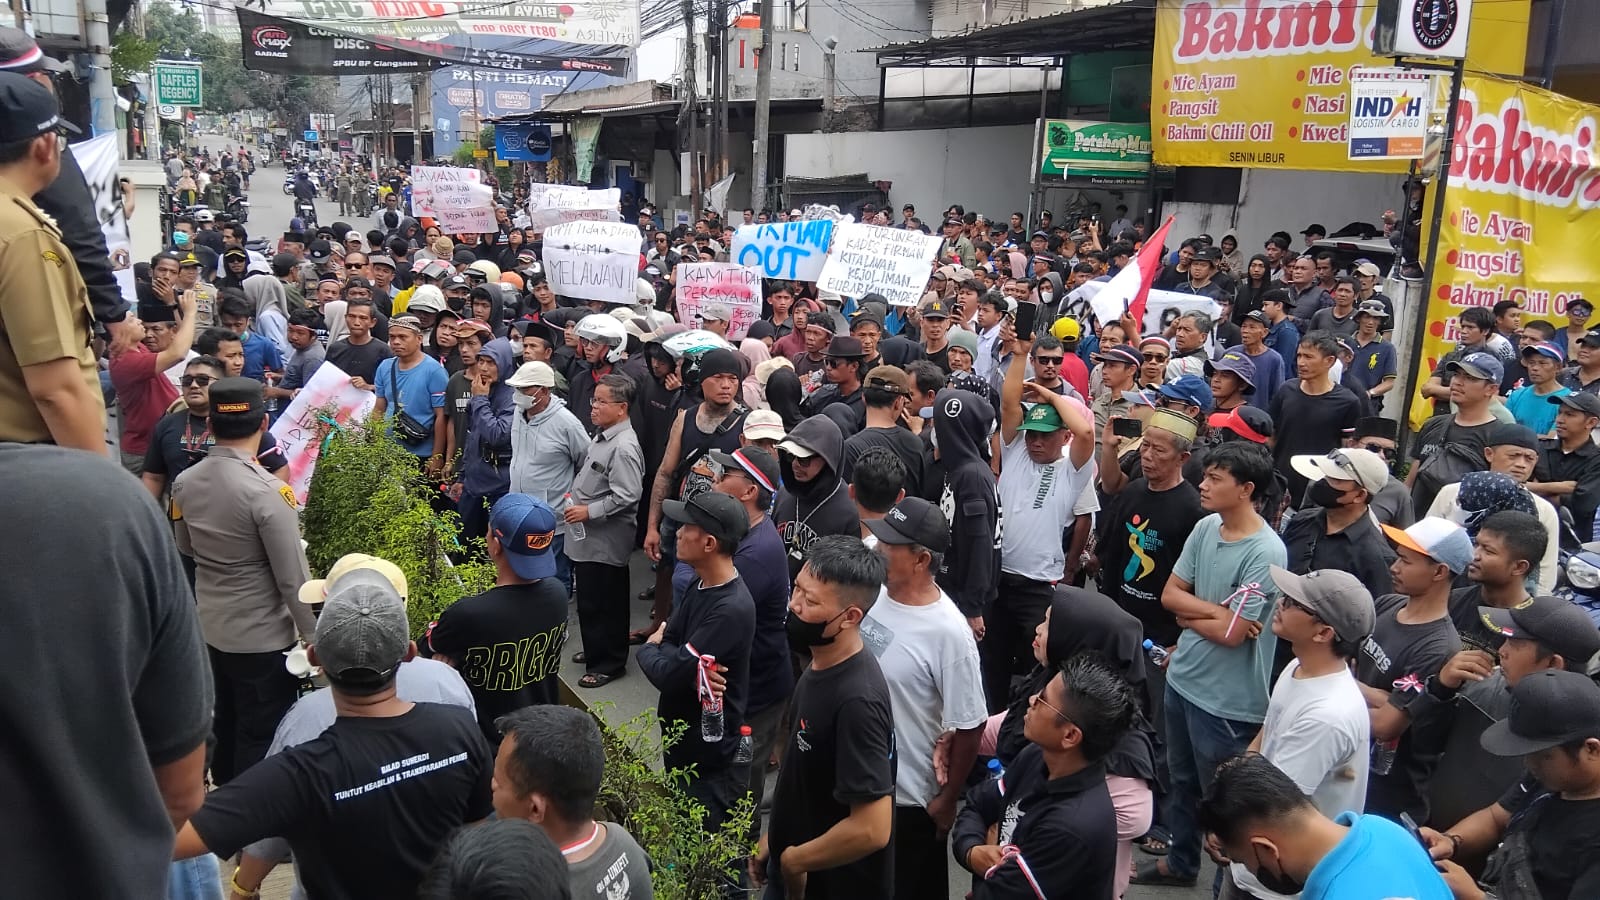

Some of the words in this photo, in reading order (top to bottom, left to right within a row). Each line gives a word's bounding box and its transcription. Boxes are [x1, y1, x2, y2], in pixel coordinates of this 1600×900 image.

[1178, 0, 1357, 57] Bakmi
[334, 38, 370, 50] DISC.
[161, 74, 197, 87] RAFFLES
[452, 70, 500, 82] PASTI
[504, 72, 568, 88] HEMAT!
[1172, 77, 1196, 91] Mie
[1198, 75, 1236, 93] Ayam
[1310, 67, 1342, 84] Mie
[161, 86, 197, 98] REGENCY
[1169, 100, 1218, 119] Pangsit
[1305, 95, 1345, 113] Nasi
[1168, 125, 1206, 140] Bakmi
[1212, 124, 1245, 140] Chili
[1250, 124, 1272, 140] Oil
[1354, 118, 1384, 128] LOGISTIK
[1392, 118, 1420, 128] CARGO
[1230, 152, 1254, 162] SENIN
[1258, 152, 1285, 163] LIBUR
[1448, 99, 1592, 198] Bakmi
[866, 226, 928, 247] TURUNKAN
[846, 238, 880, 254] KADES
[884, 244, 925, 259] FIRMAN
[738, 244, 811, 280] OUT
[550, 260, 624, 289] MELAWAN
[680, 286, 739, 303] PERCAYA
[1033, 466, 1055, 510] WORKING
[402, 753, 430, 768] SUHERDI
[334, 786, 364, 800] TUNTUT
[402, 759, 449, 780] TRANSPARANSI
